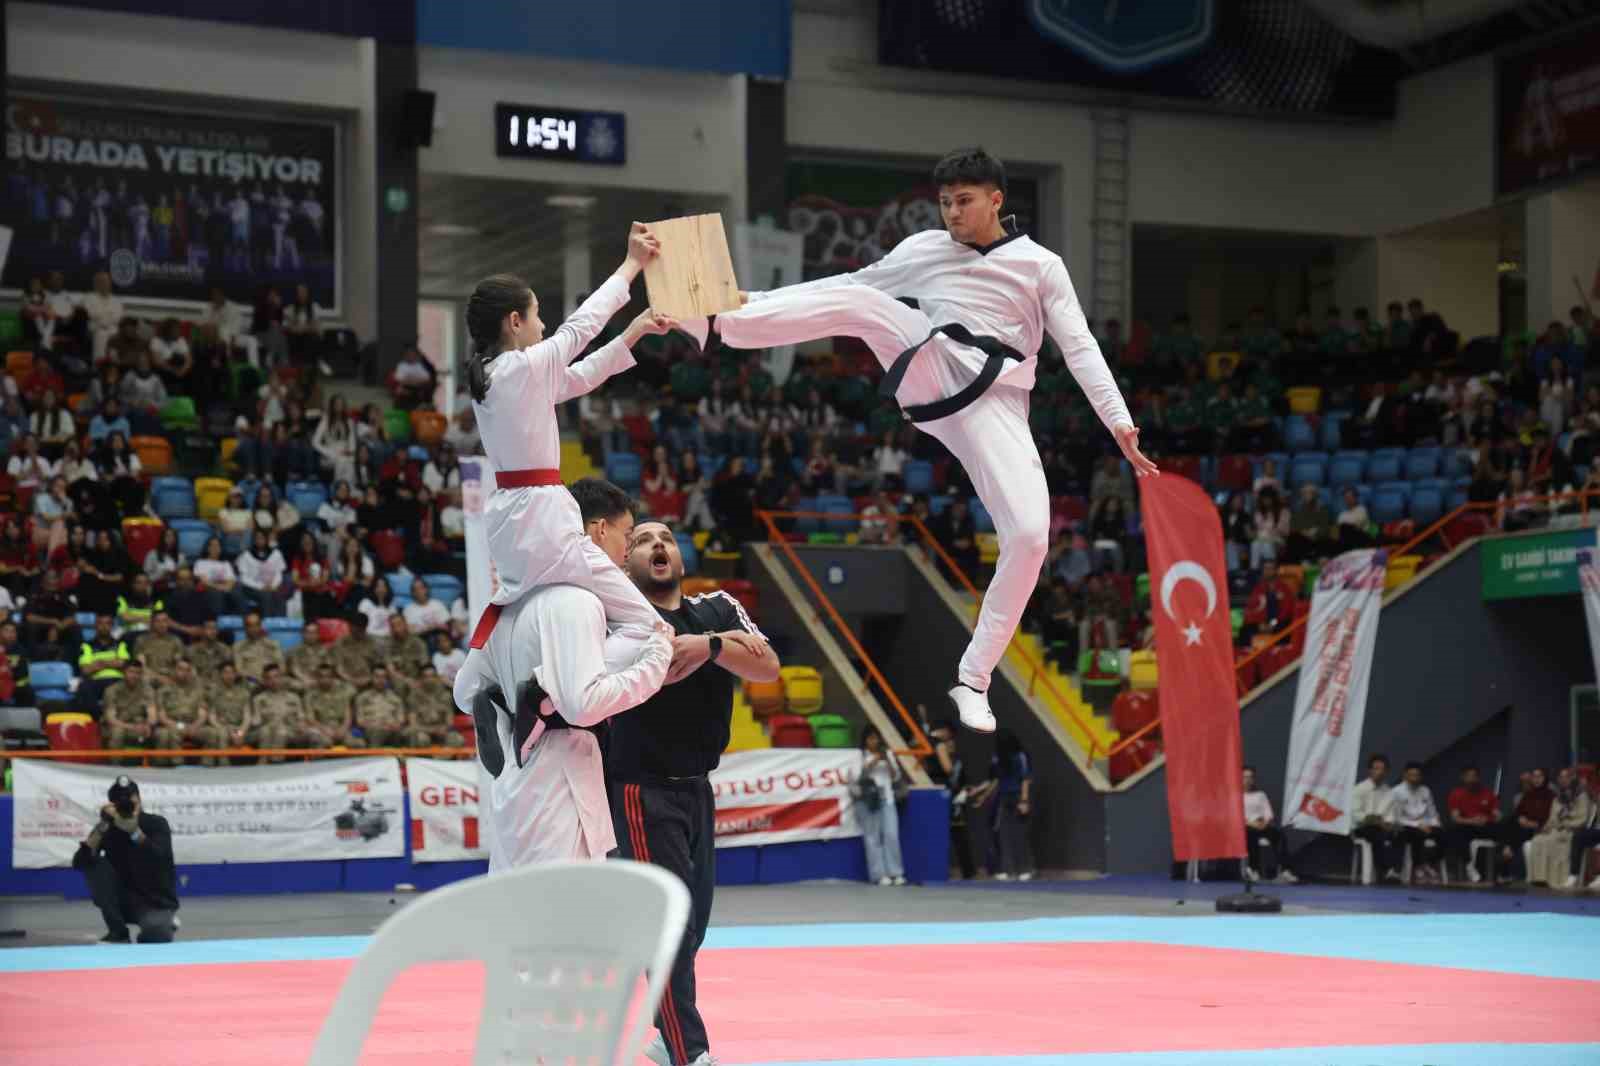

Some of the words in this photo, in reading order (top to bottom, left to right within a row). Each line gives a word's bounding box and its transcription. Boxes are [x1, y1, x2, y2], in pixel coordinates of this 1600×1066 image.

[5, 132, 149, 171] BURADA
[157, 145, 322, 184] YETİŞİYOR
[420, 785, 480, 806] GEN
[714, 776, 774, 799] UTLU
[784, 767, 851, 791] OLSU
